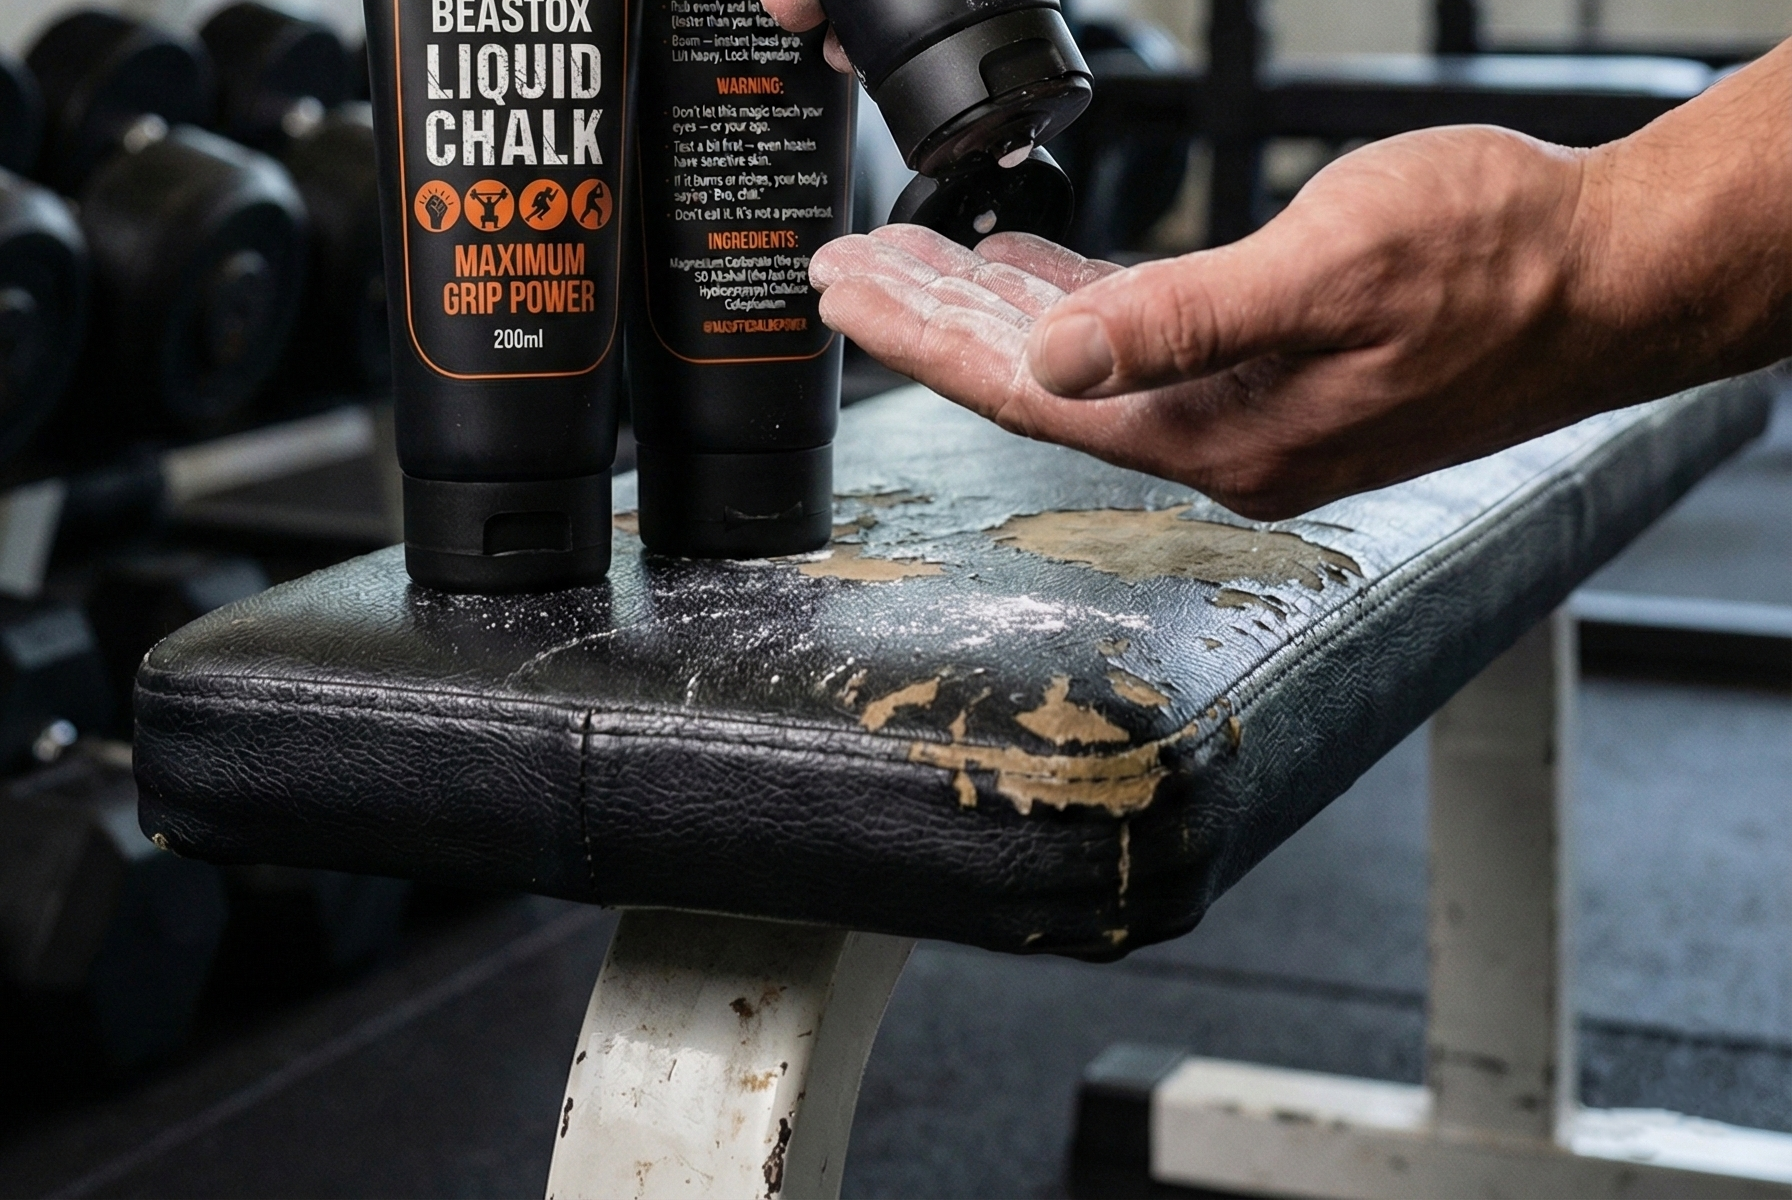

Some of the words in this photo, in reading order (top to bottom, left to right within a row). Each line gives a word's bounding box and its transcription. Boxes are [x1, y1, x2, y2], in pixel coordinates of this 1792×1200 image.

[426, 43, 602, 106] LIQUID
[716, 77, 785, 95] WARNING:
[739, 105, 770, 121] magic
[425, 108, 603, 166] CHALK
[674, 140, 695, 153] Test
[708, 230, 799, 250] INGREDIENTS:
[454, 243, 585, 278] MAXIMUM
[443, 282, 502, 315] GRIP
[510, 279, 595, 314] POWER
[493, 329, 544, 349] 200ml
